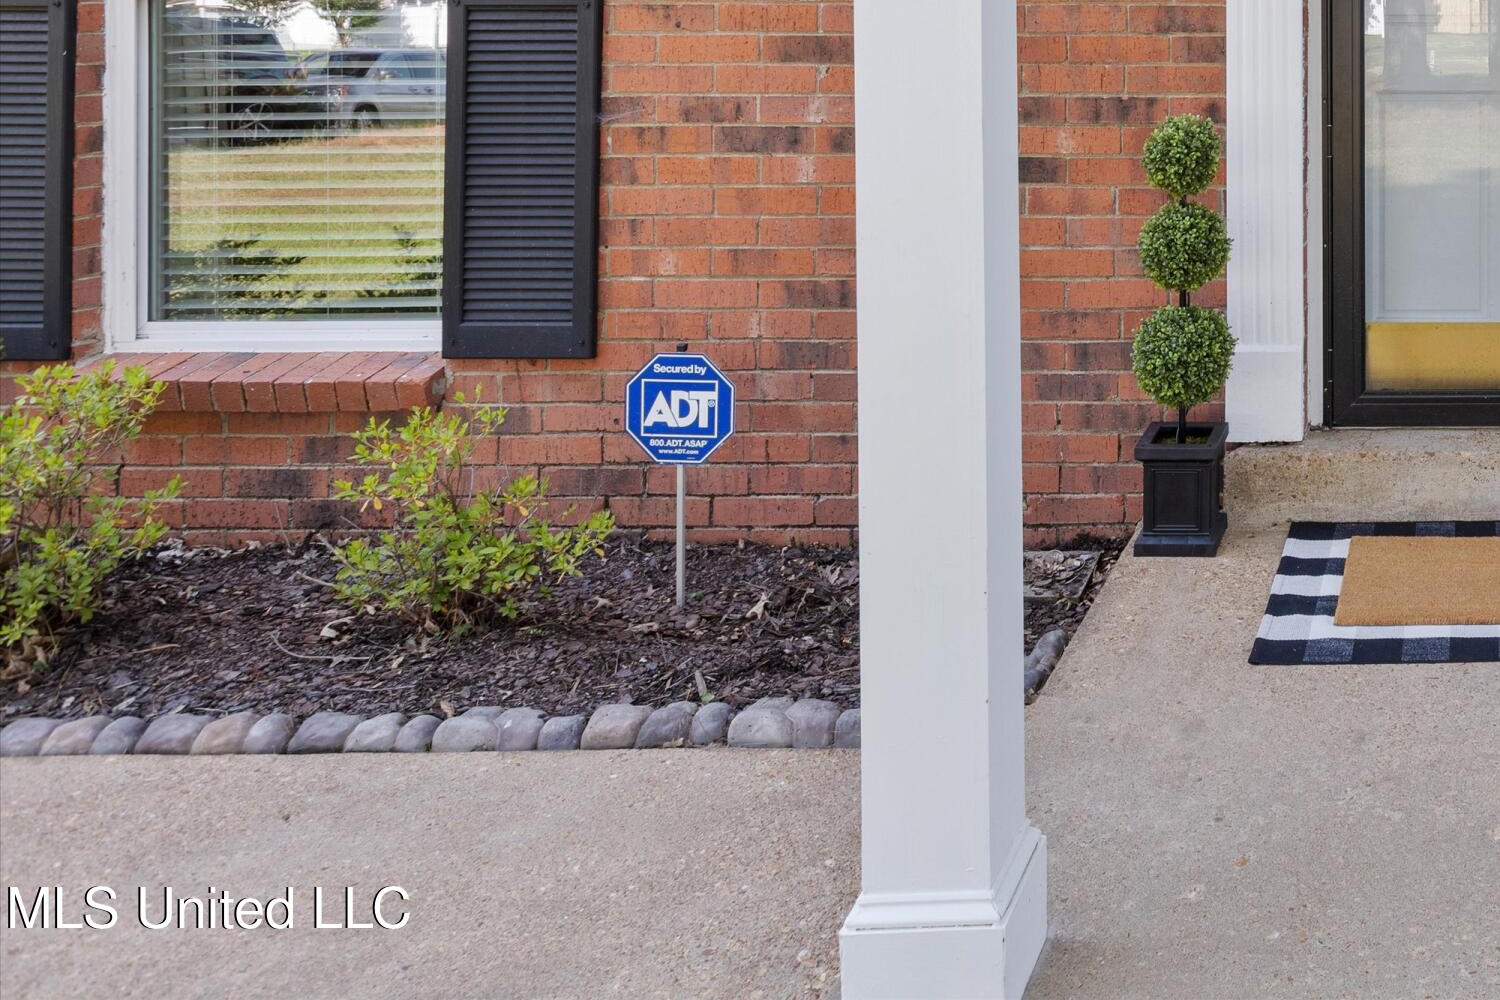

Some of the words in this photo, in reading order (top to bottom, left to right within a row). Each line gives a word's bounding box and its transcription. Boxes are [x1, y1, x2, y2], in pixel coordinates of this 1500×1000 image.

[653, 363, 693, 374] Secured
[694, 364, 707, 376] by
[643, 390, 716, 428] ADT
